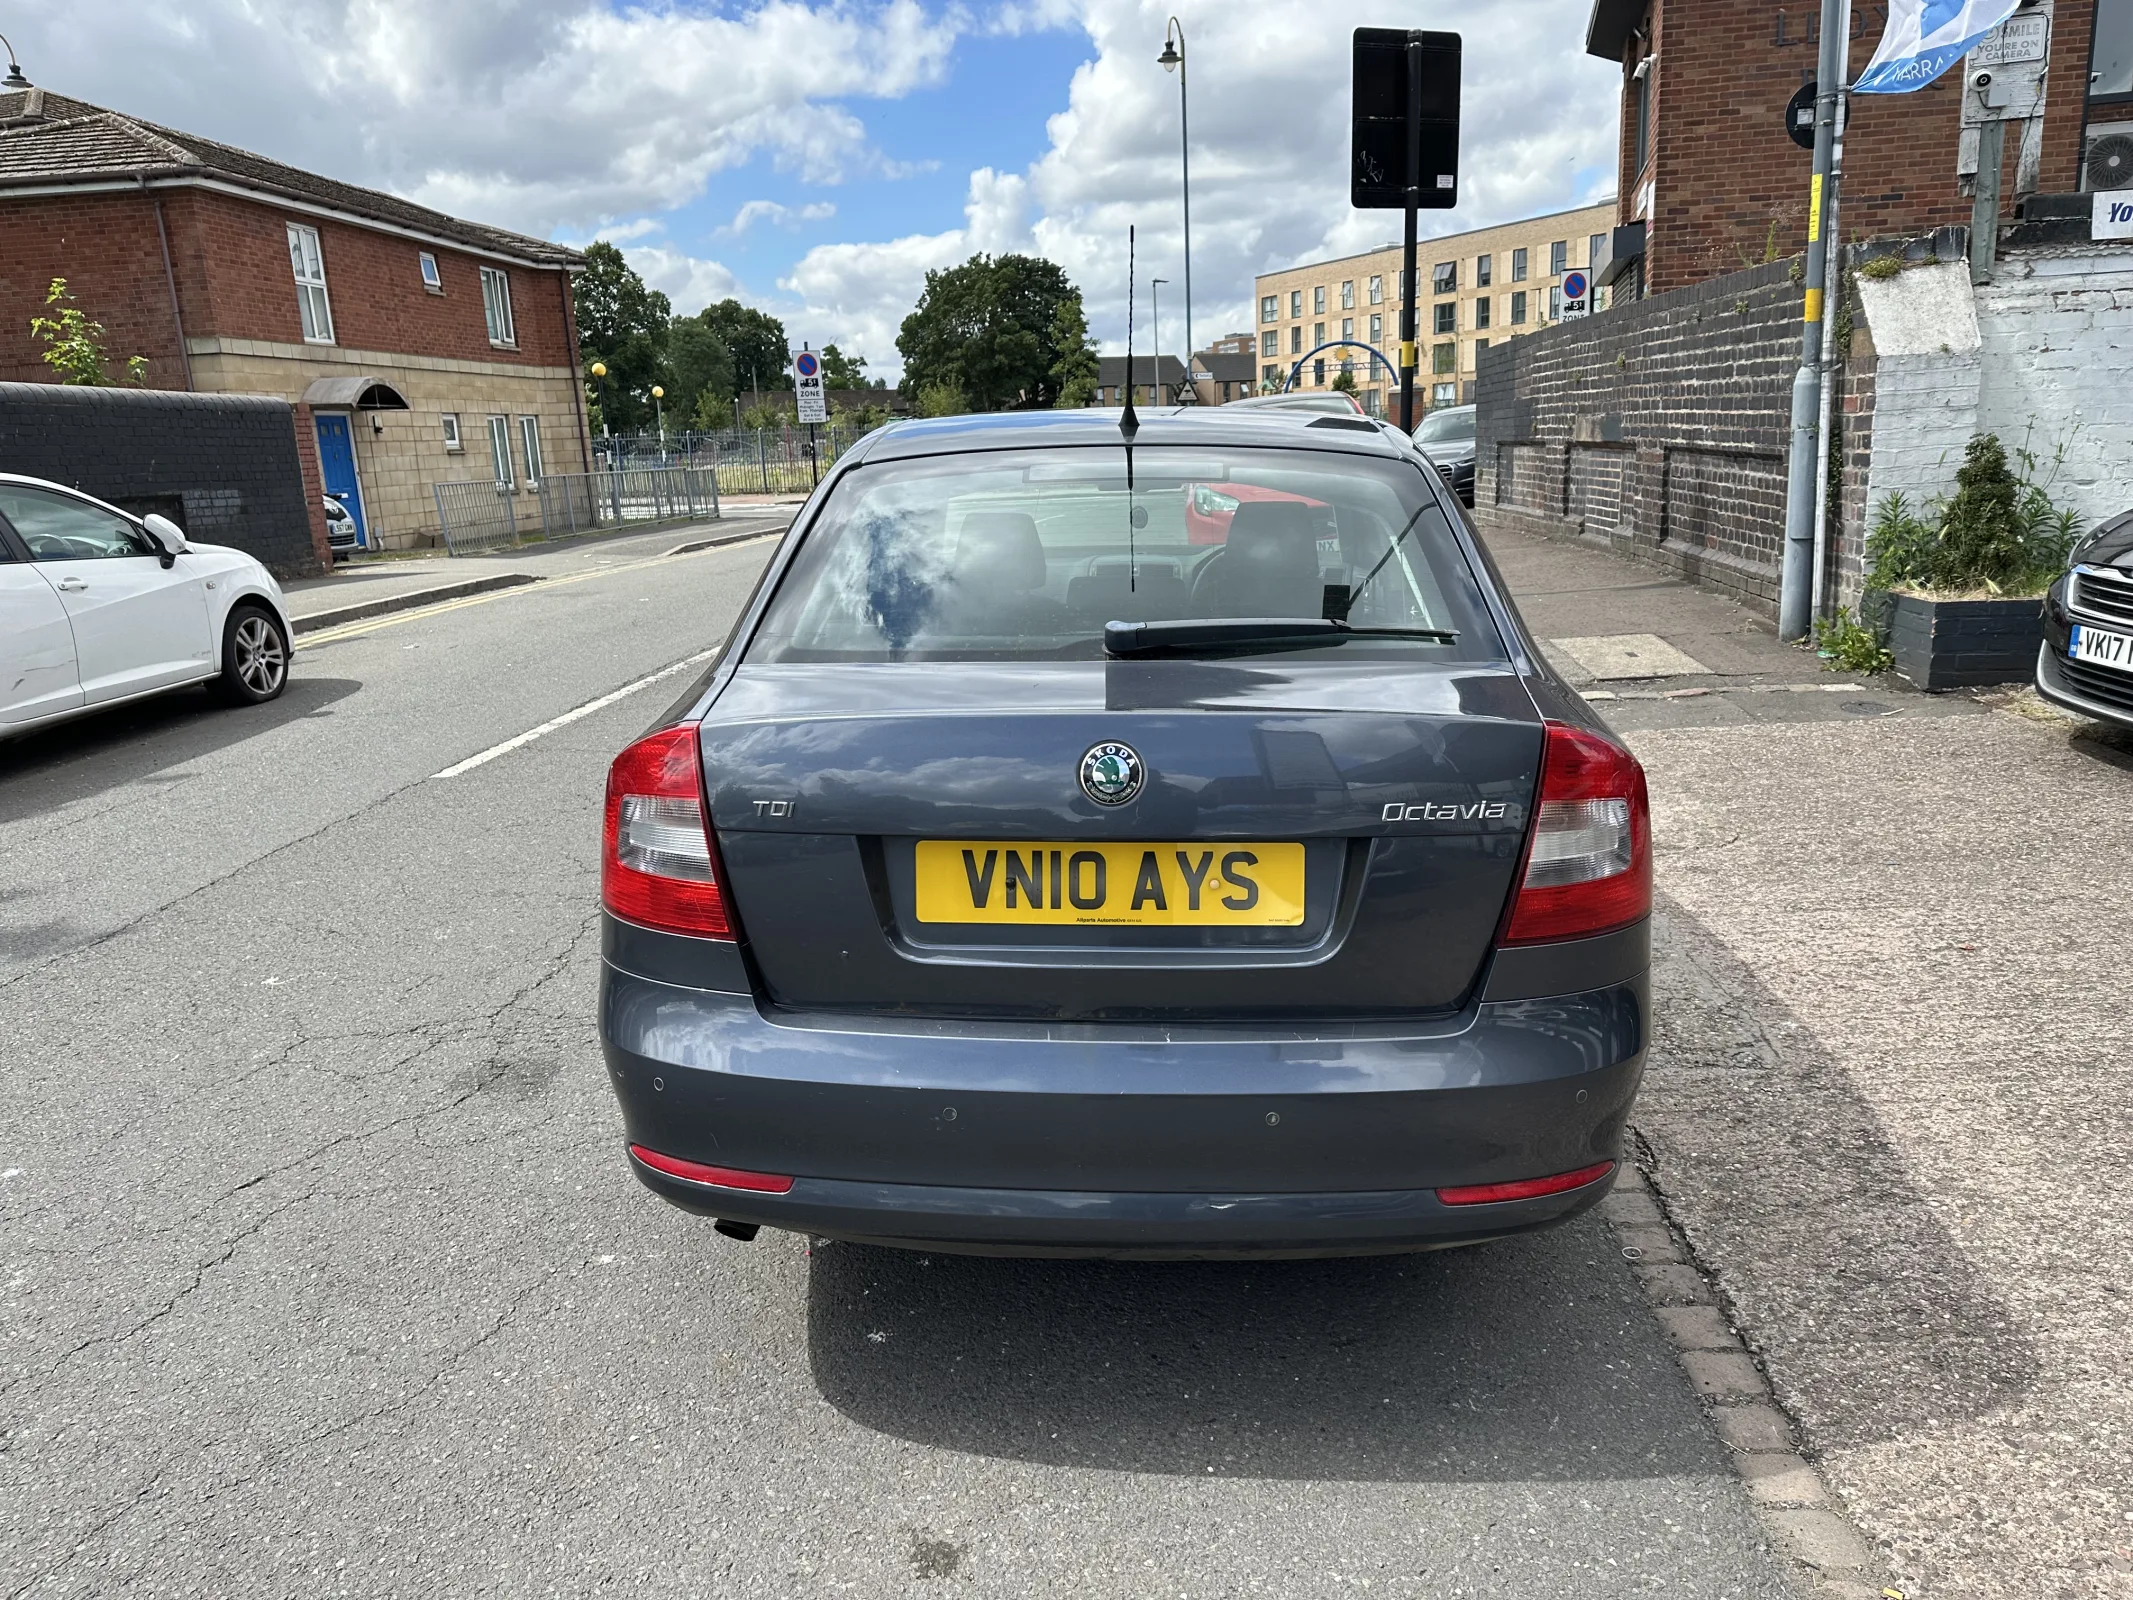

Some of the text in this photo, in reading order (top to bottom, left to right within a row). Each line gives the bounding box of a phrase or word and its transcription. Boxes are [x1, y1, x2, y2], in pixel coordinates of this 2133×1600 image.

[2000, 24, 2040, 38] SMILE
[1978, 39, 2039, 53] YOURE ON
[1985, 49, 2031, 60] CAMERA
[2086, 630, 2124, 662] VK17
[752, 800, 796, 818] TDI
[1381, 800, 1507, 821] Octavia
[961, 849, 1259, 911] VN10 AYS
